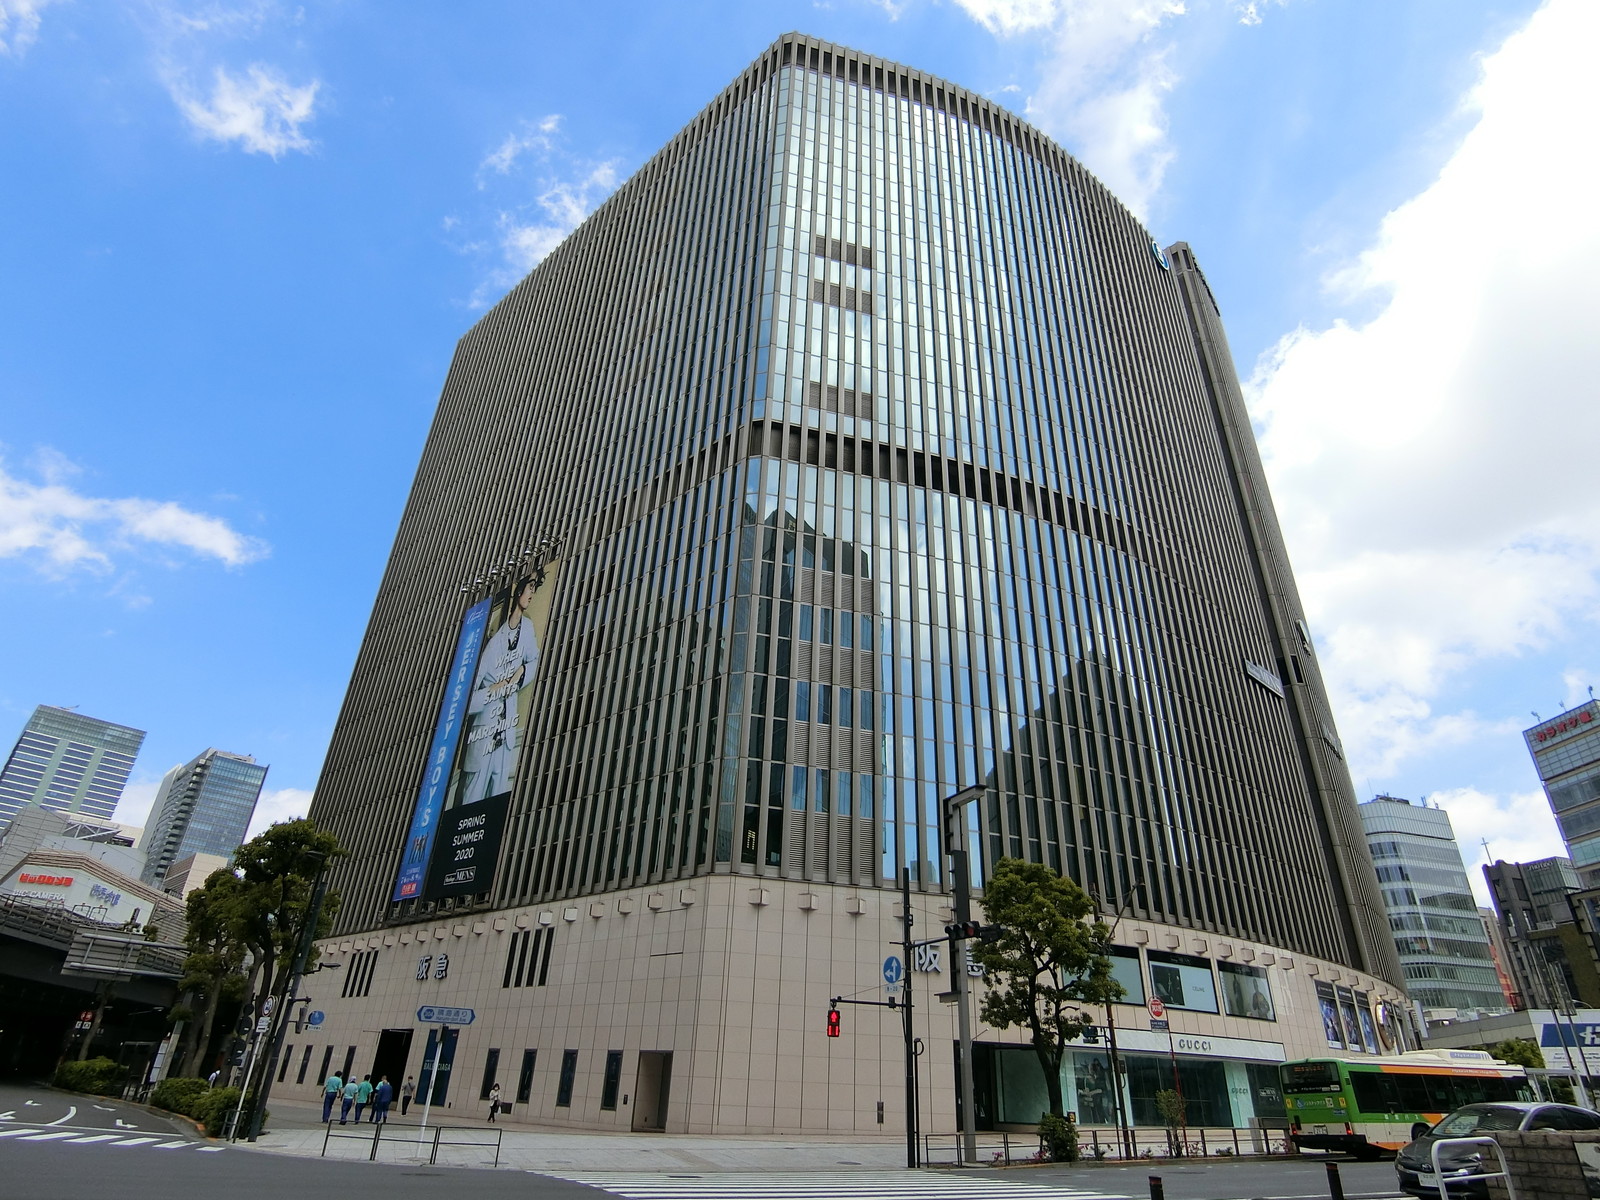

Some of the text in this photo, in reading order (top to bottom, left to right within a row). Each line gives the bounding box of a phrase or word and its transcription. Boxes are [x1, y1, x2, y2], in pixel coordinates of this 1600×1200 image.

[496, 646, 525, 669] WHEN
[497, 666, 515, 683] THE
[484, 682, 520, 705] SAINTS
[421, 631, 475, 828] JERSEY BOYS
[467, 715, 520, 745] MARCHING
[458, 814, 486, 830] SPRING
[452, 830, 484, 846] SUMMER
[454, 847, 474, 861] 2020
[417, 954, 448, 980] 阪急
[1179, 1039, 1212, 1051] GUCCI
[423, 1062, 451, 1071] BALCIAGA
